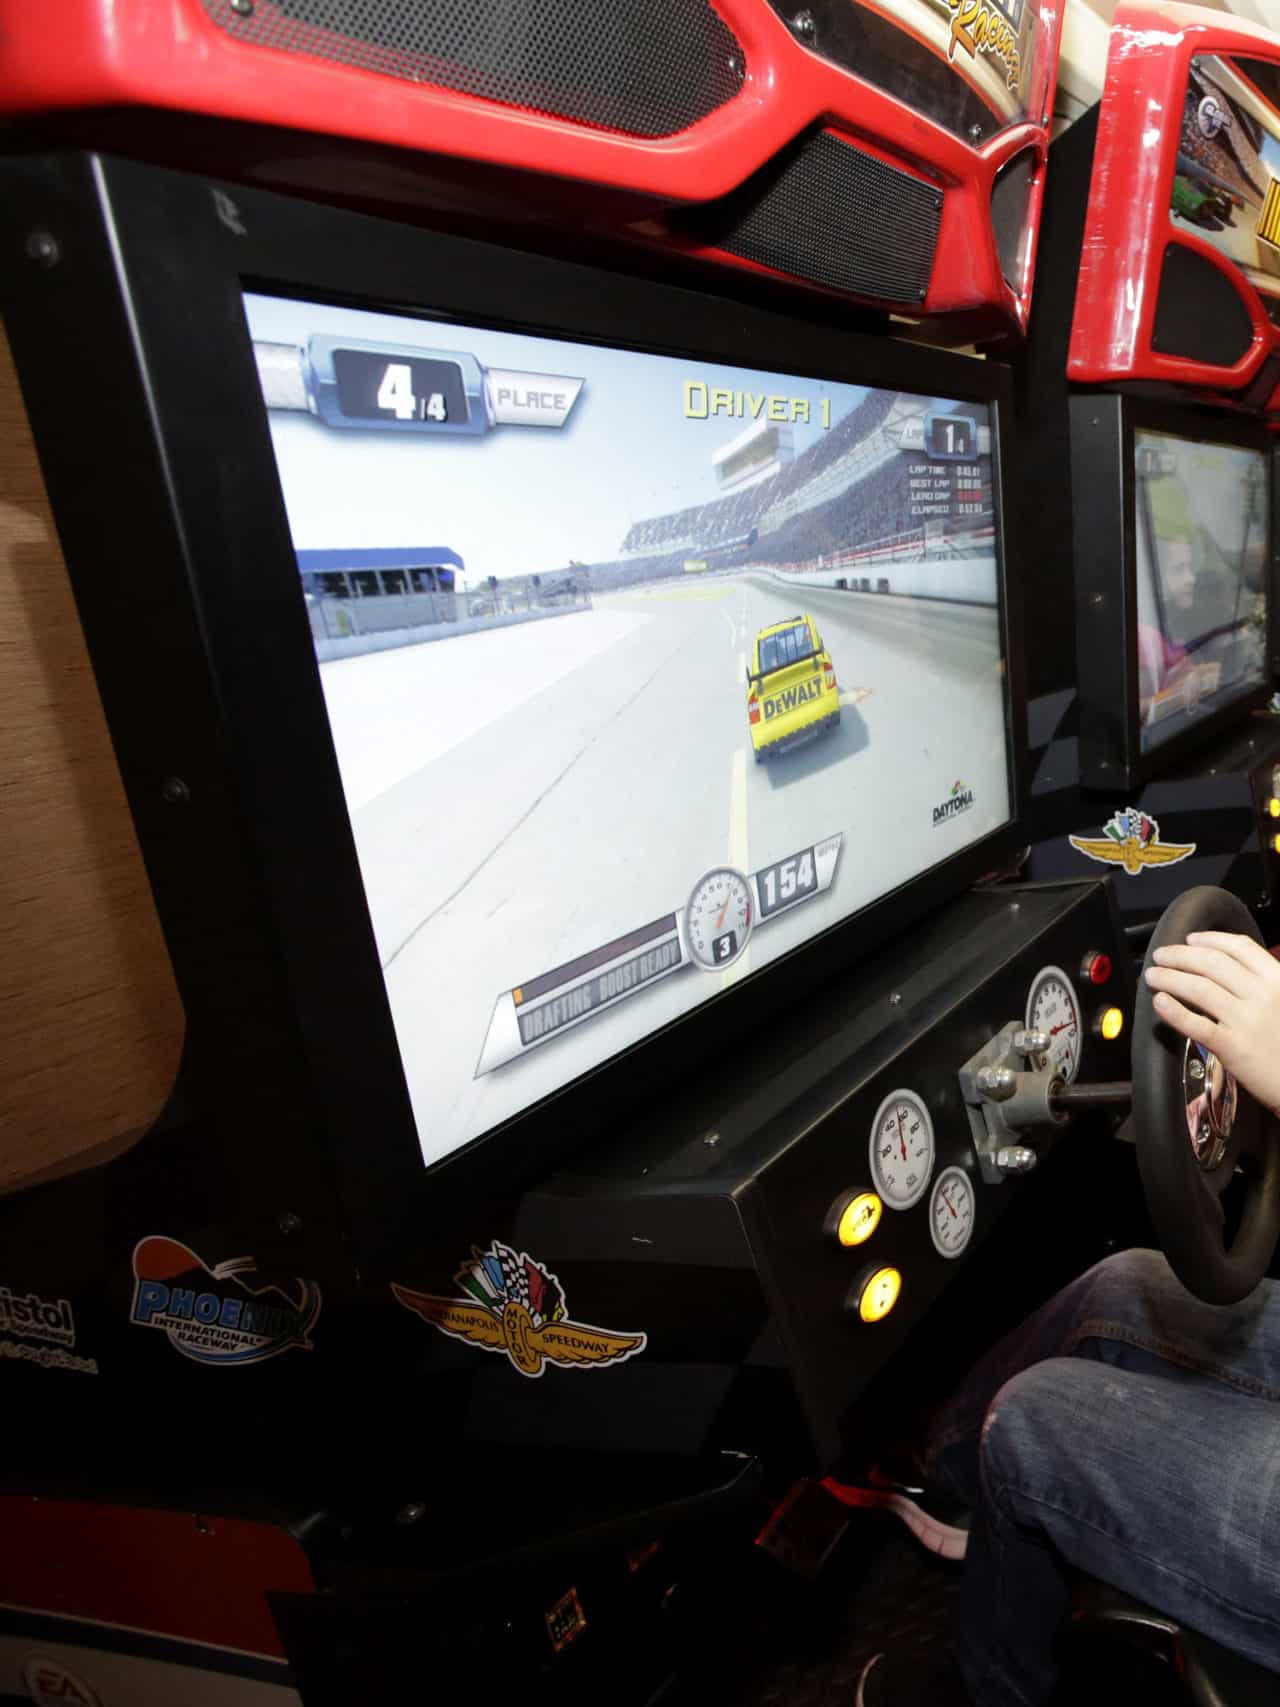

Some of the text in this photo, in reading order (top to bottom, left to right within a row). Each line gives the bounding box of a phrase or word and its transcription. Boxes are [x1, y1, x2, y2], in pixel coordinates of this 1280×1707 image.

[377, 364, 416, 420] 4
[497, 388, 567, 411] PLACE
[683, 380, 832, 430] DRIVER 1
[932, 789, 974, 822] DAYTONA
[764, 852, 813, 907] 154
[719, 935, 731, 958] 3
[523, 941, 679, 1042] DRAFTING BOOST READY
[136, 1280, 267, 1333] PHOEN
[439, 1309, 500, 1331] DIANAPOLIS
[154, 1317, 257, 1346] INTERNATIONAL
[177, 1332, 239, 1351] RACEWAY
[506, 1307, 529, 1367] MOTOR
[541, 1332, 609, 1353] SPEEDWAY
